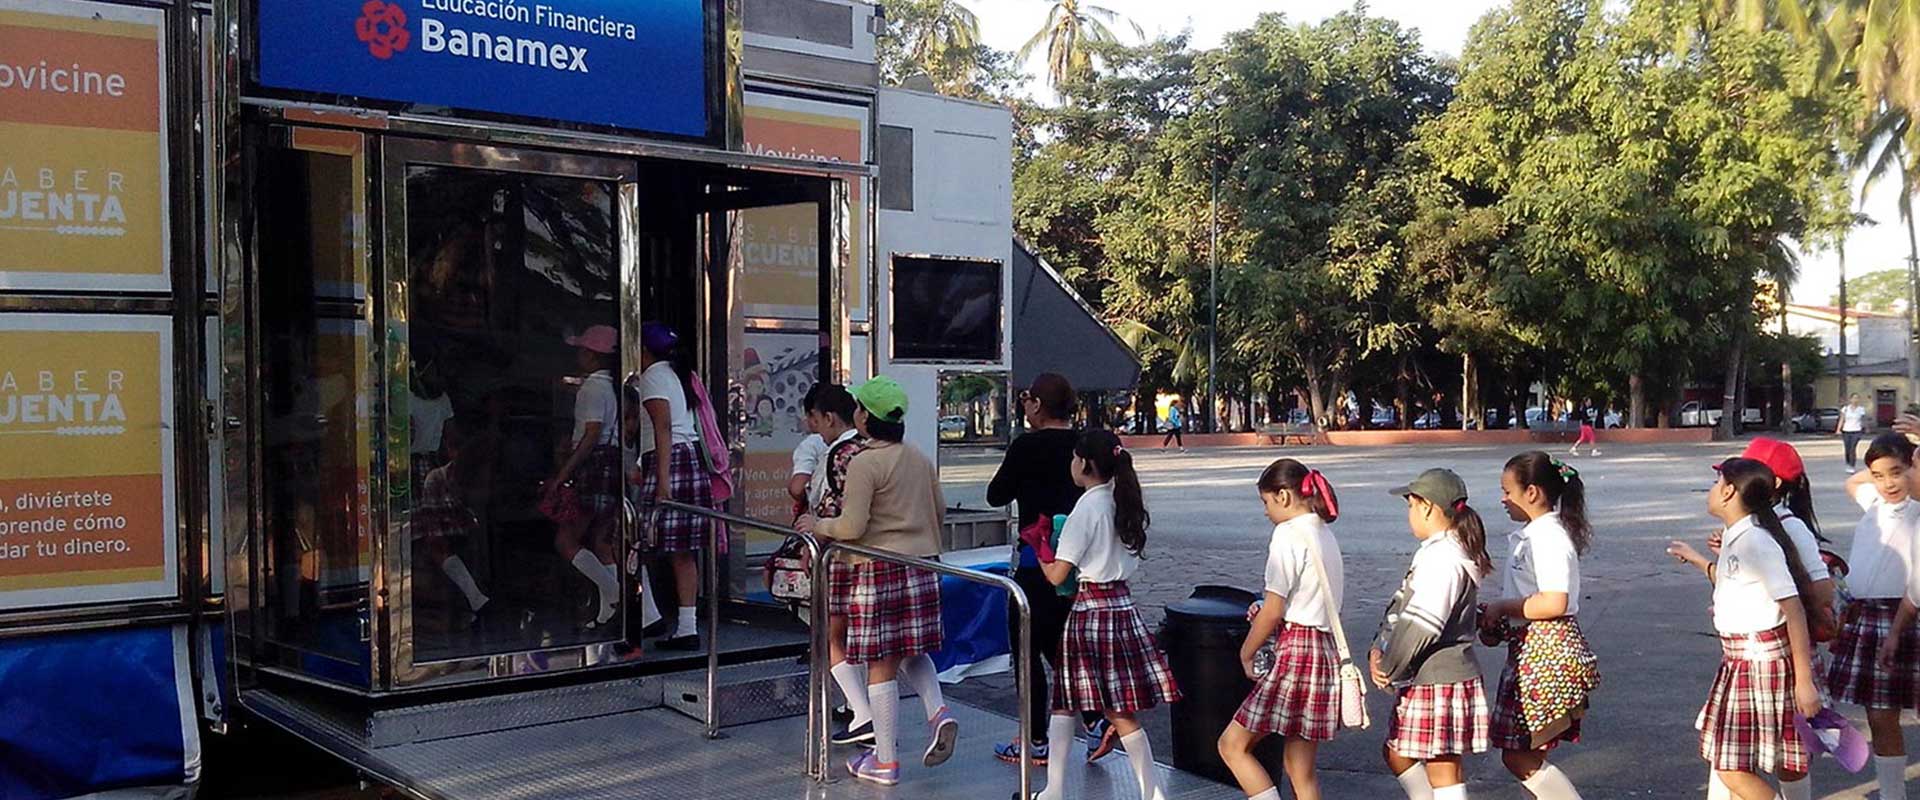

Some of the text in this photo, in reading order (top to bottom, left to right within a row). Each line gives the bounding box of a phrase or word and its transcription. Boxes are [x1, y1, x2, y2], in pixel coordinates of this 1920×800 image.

[535, 5, 636, 41] Financiera
[421, 18, 589, 73] Banamex
[15, 490, 113, 511] diviértete
[73, 513, 127, 531] cómo
[36, 540, 57, 557] tu
[64, 537, 131, 556] dinero.
